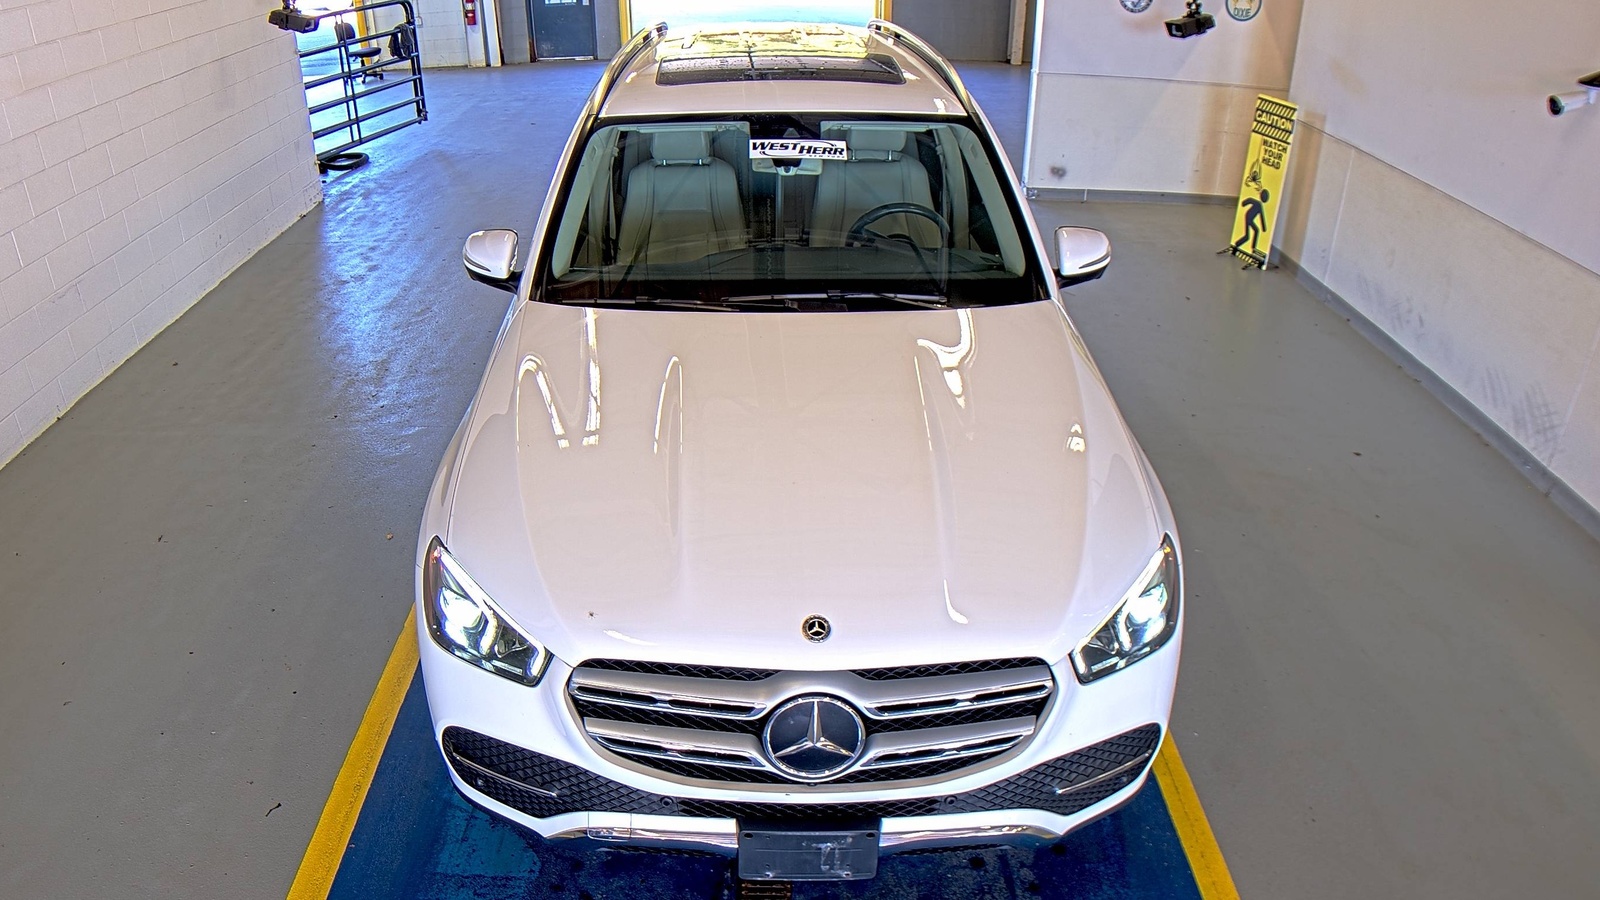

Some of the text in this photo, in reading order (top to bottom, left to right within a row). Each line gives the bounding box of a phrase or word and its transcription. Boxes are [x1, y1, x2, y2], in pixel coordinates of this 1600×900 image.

[1256, 110, 1291, 130] CAUTION
[752, 142, 845, 155] WEST HERR
[1263, 138, 1288, 153] WATCH
[1264, 148, 1283, 161] YOUR
[1262, 156, 1281, 169] HEAD
